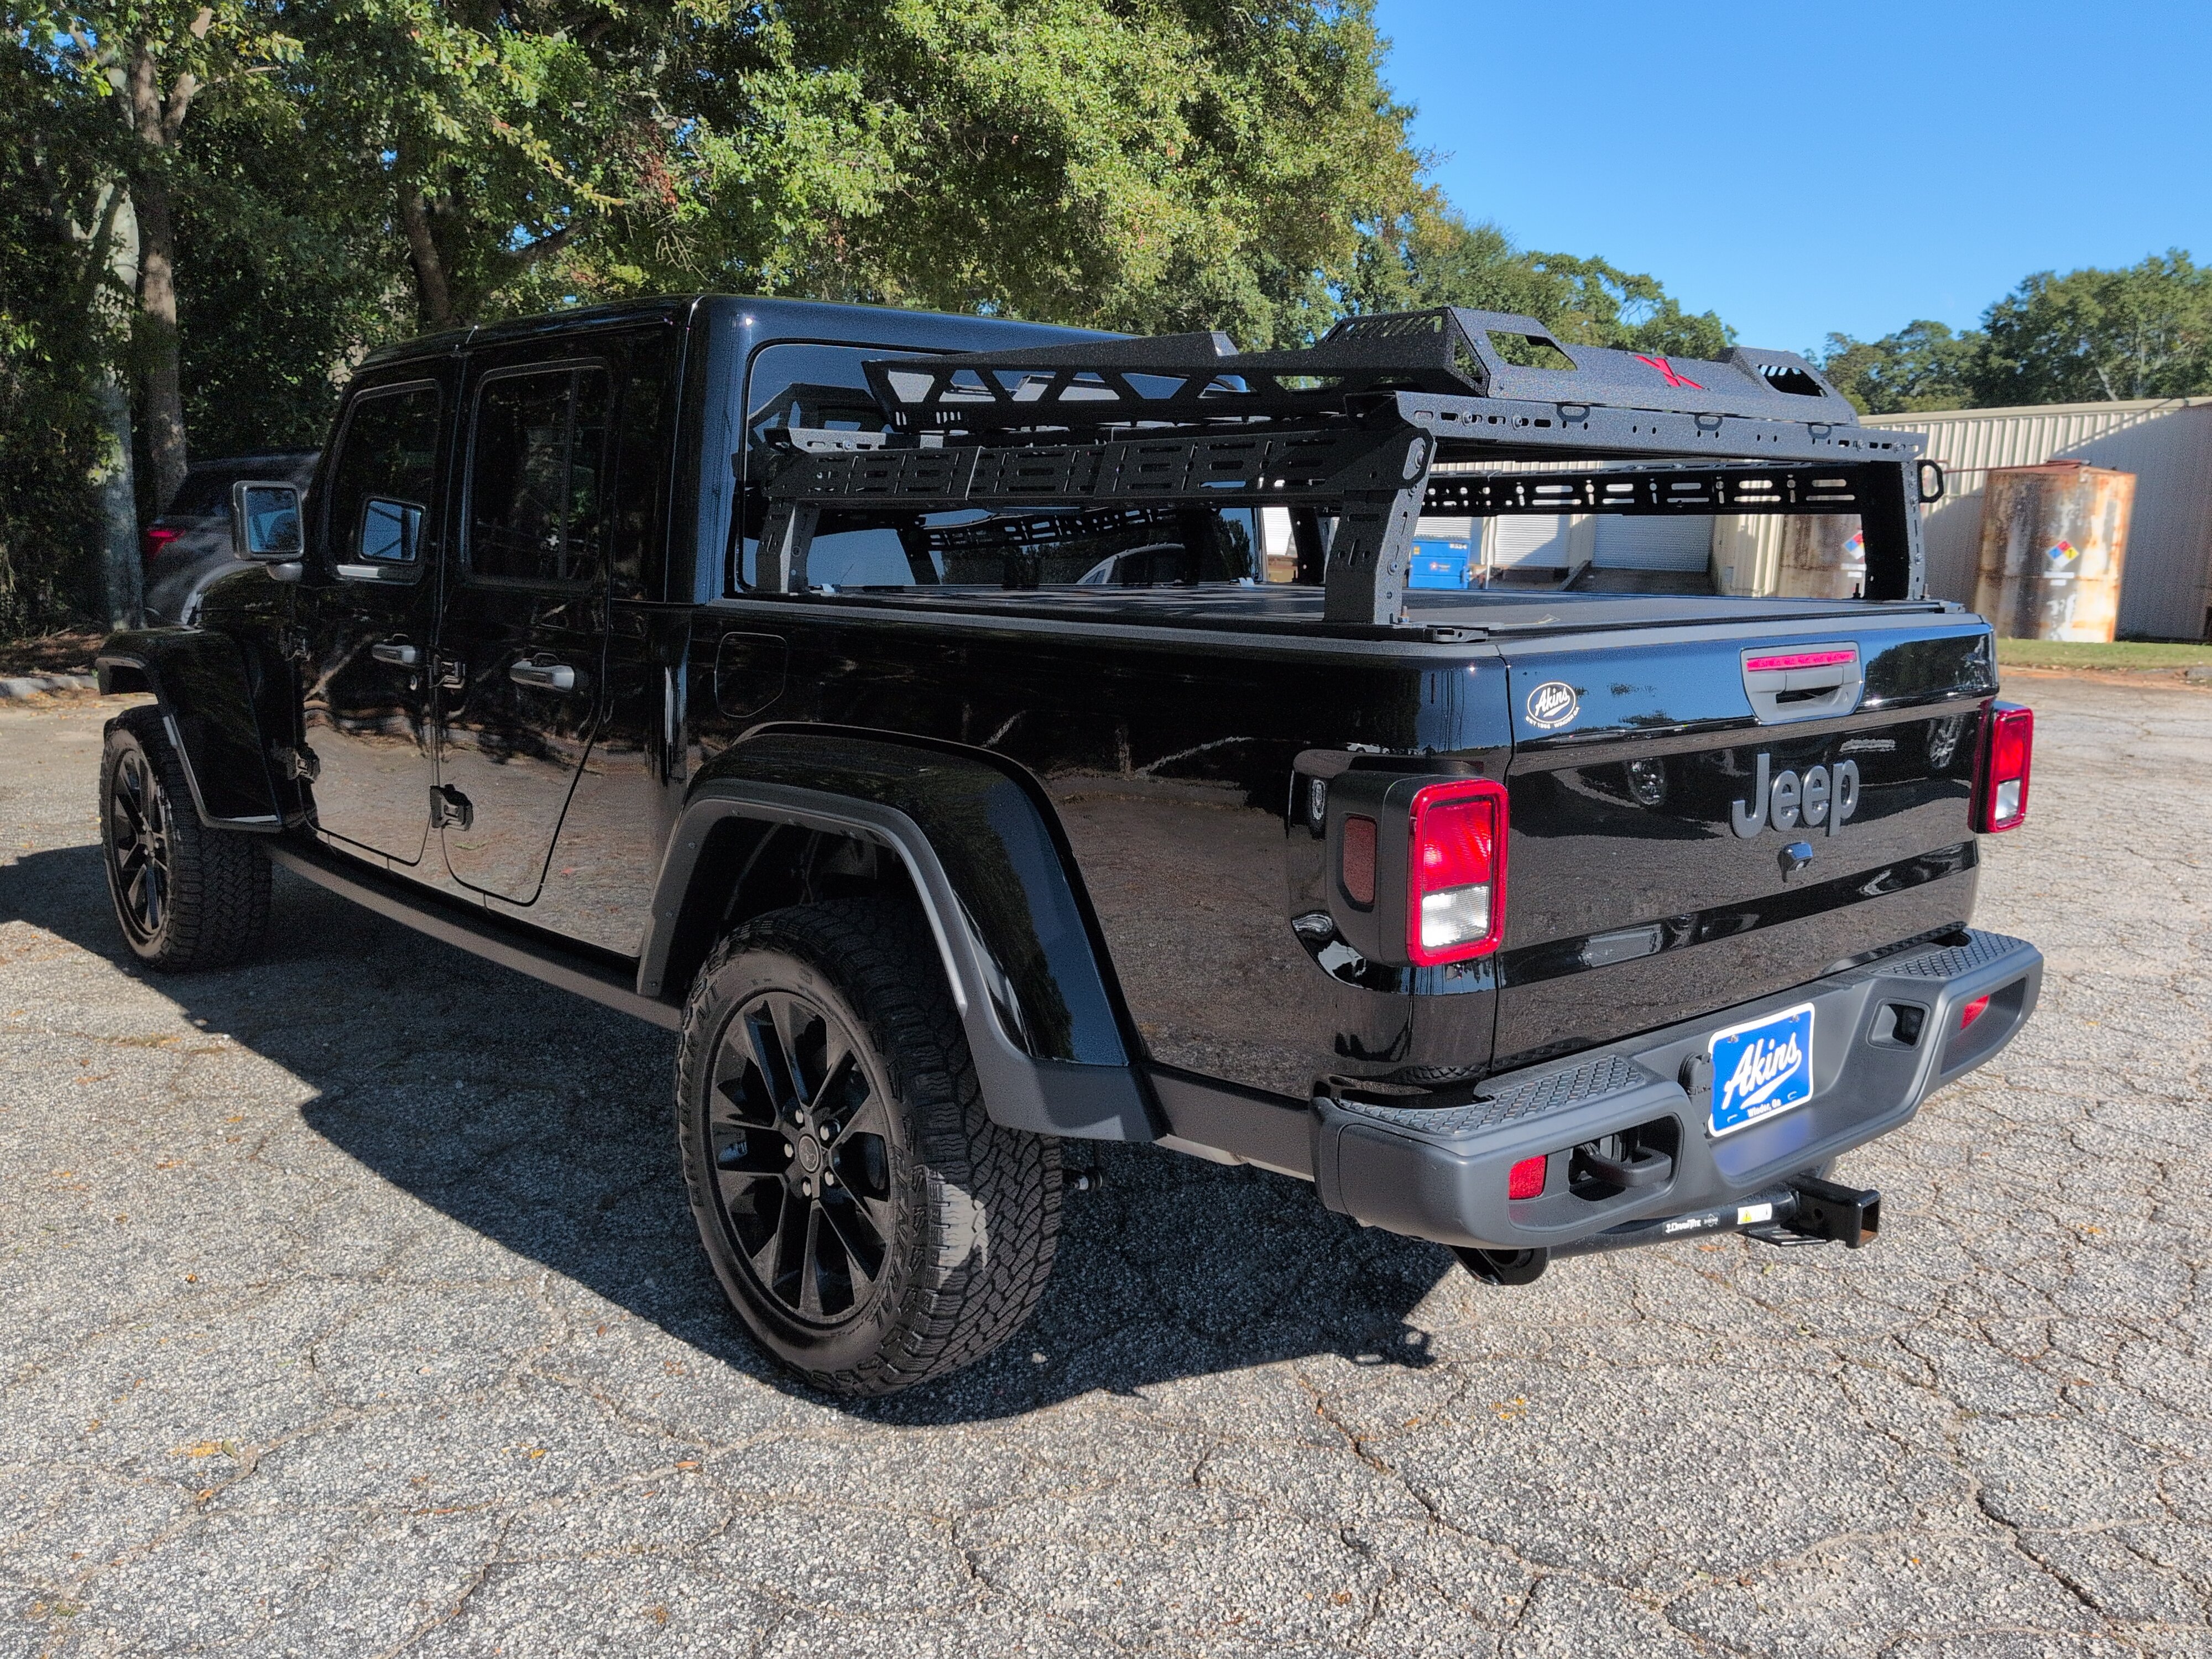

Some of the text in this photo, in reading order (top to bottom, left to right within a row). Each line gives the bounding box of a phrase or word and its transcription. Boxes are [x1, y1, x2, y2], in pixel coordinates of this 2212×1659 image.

[1535, 687, 1571, 717] Akins
[1553, 715, 1574, 728] WINDER
[1730, 753, 1860, 839] Jeep
[1721, 1032, 1802, 1110] Akins
[870, 1144, 909, 1330] GENERAL
